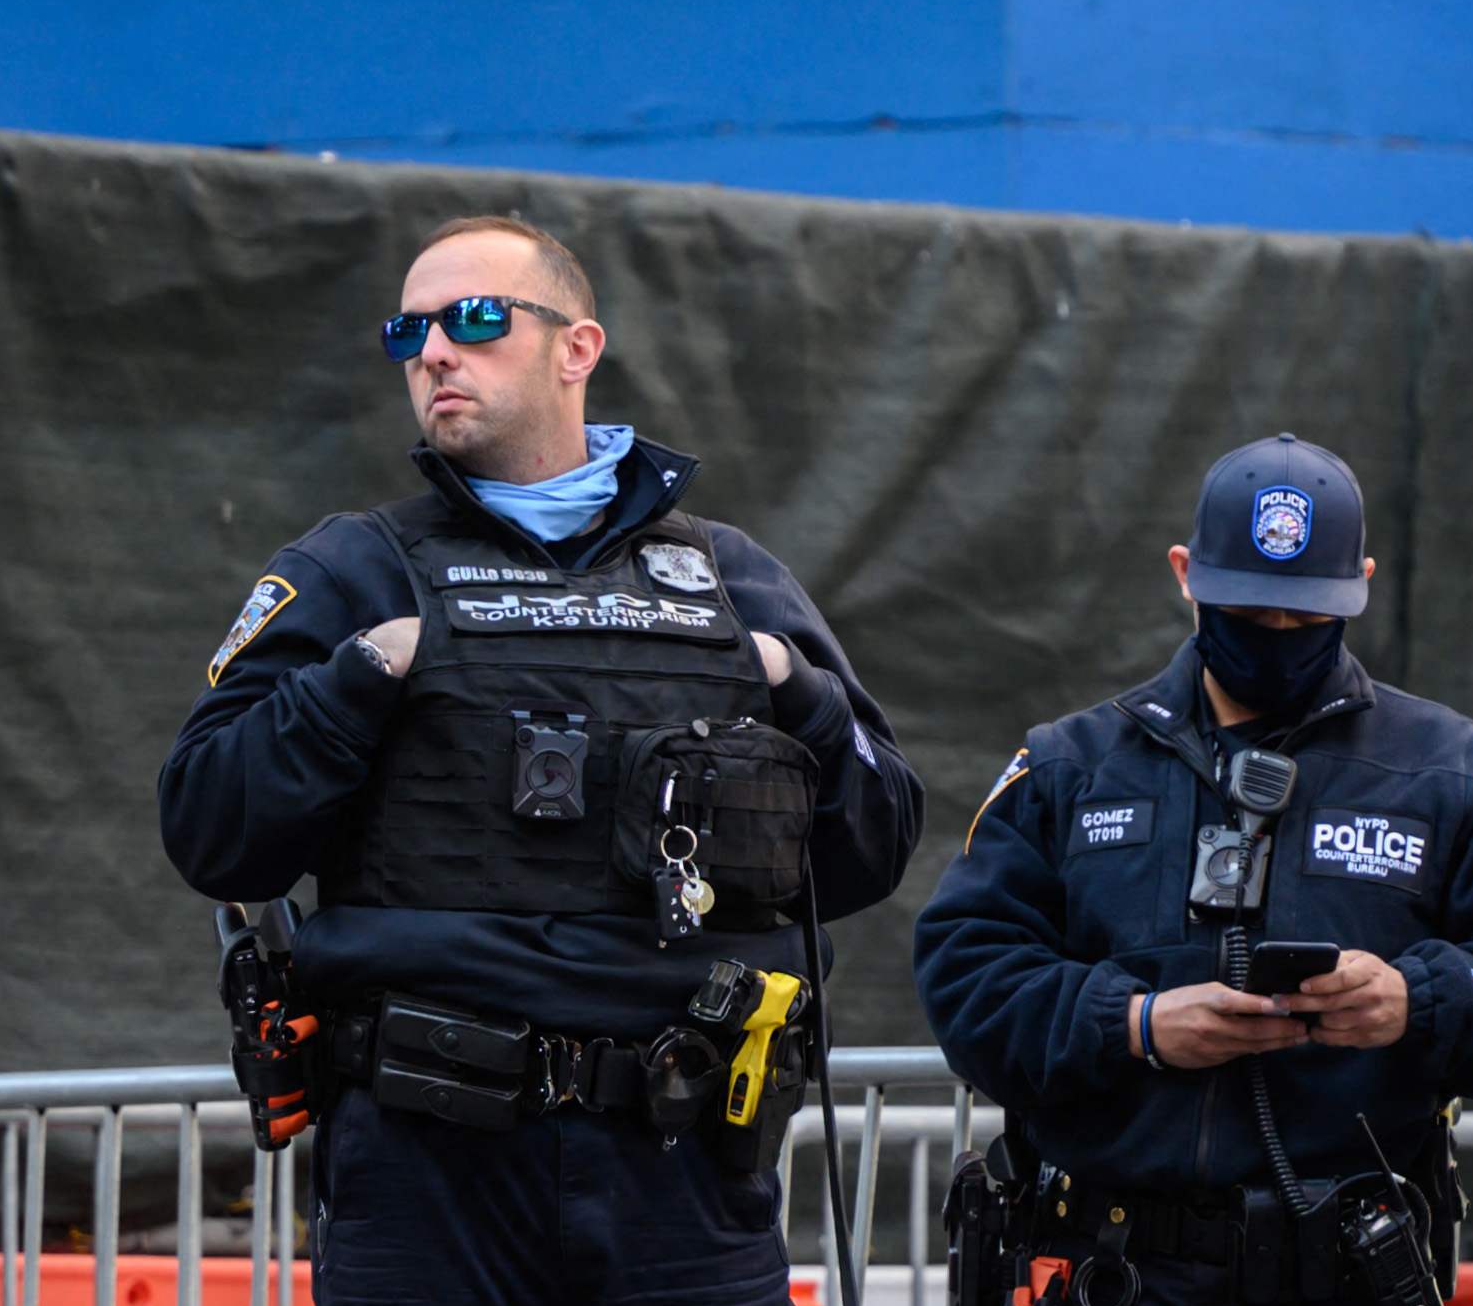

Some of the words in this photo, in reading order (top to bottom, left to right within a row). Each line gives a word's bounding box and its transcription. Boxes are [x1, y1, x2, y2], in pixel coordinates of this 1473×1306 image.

[1260, 491, 1308, 518] POLICE
[458, 594, 717, 618] NYPD
[471, 606, 710, 628] COUNTERTERRORISM
[532, 616, 580, 627] K-9
[589, 616, 655, 629] UNIT
[1082, 808, 1135, 828] GOMEZ
[1355, 817, 1389, 831] NYPD
[1088, 825, 1124, 843] 17019
[1313, 824, 1425, 866] POLICE
[1315, 849, 1417, 874] COUNTERTERRORISM
[1347, 862, 1388, 877] BUREAU
